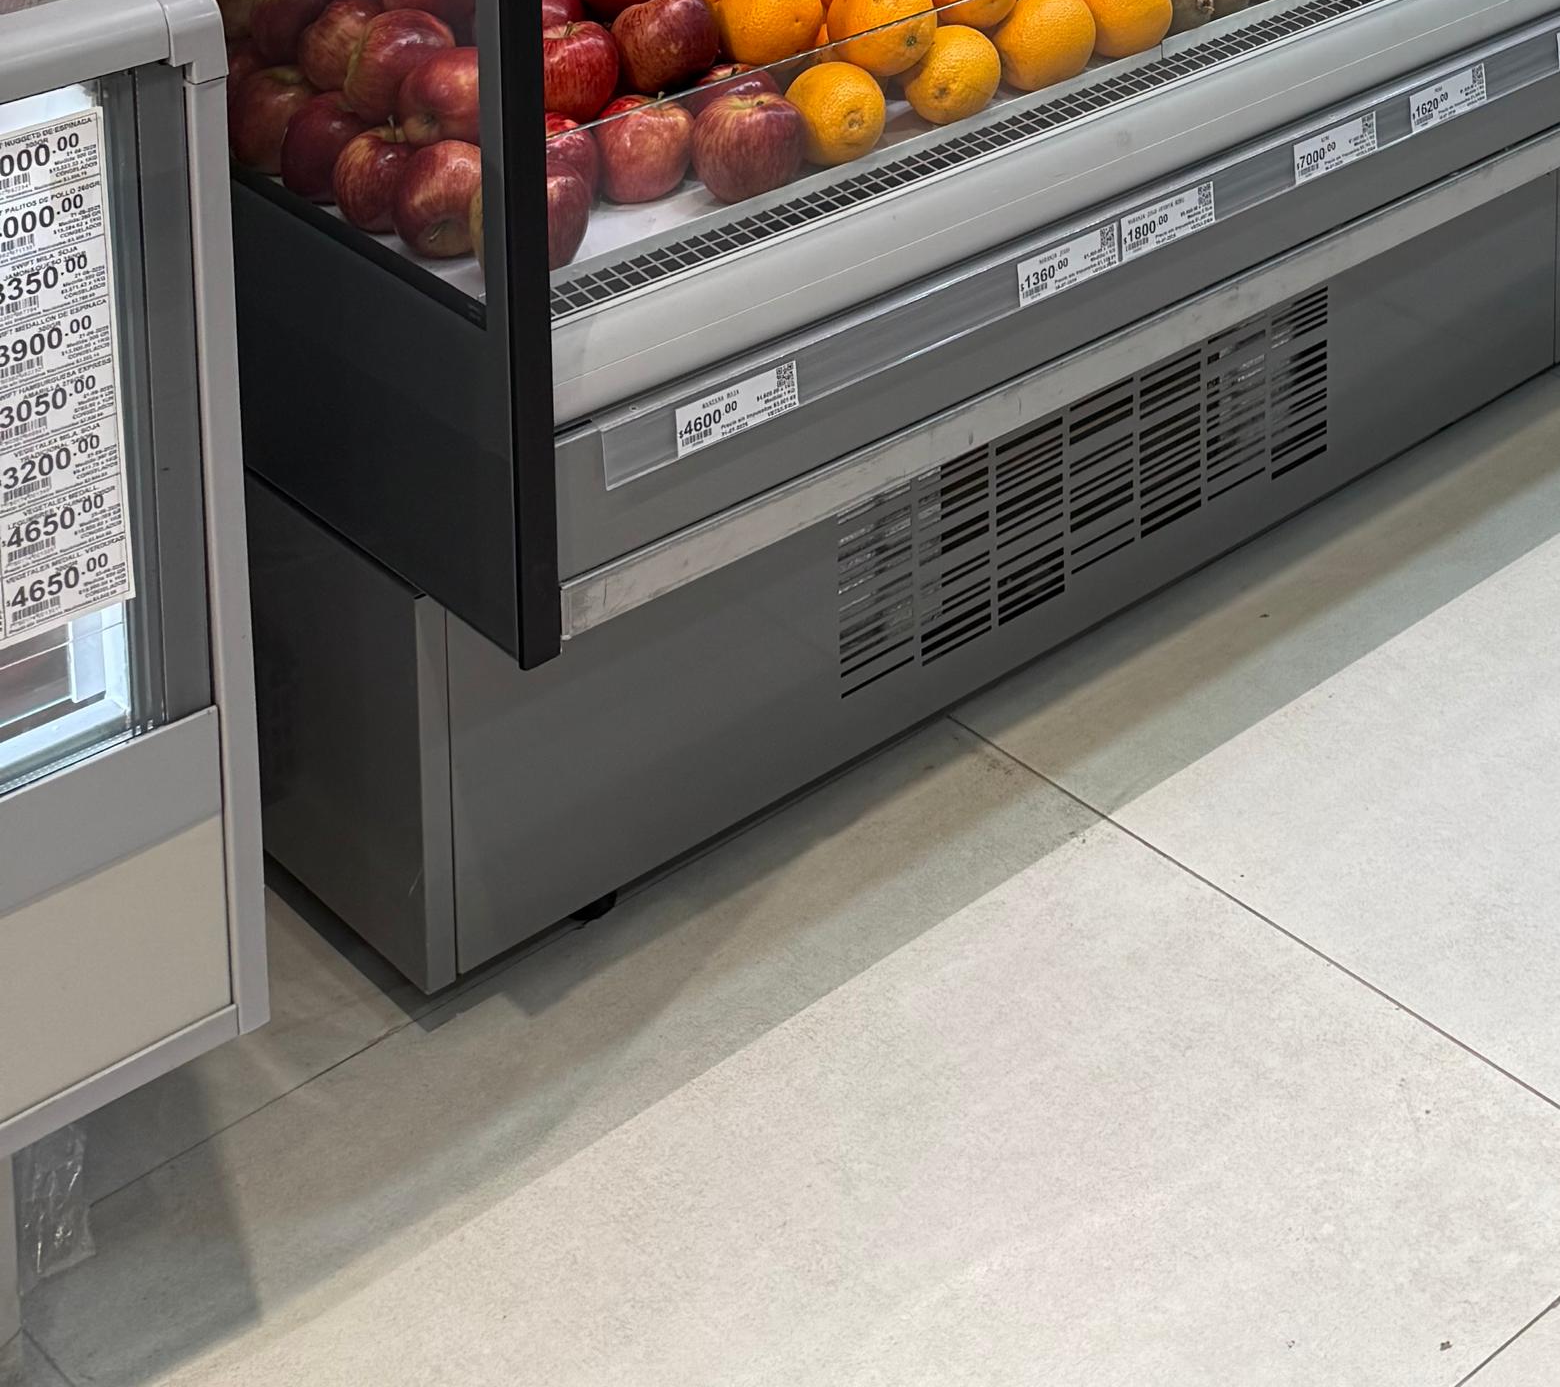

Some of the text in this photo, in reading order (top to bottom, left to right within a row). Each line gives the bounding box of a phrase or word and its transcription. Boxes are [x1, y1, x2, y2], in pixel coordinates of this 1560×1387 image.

[5, 117, 92, 148] NUGGETS DE ESPINACA
[0, 133, 79, 176] 000.00
[55, 161, 98, 178] CONGELADOS
[5, 200, 37, 214] PALITOS
[51, 188, 76, 201] POLLO
[0, 194, 83, 238] 000.00
[58, 246, 78, 256] SOJA
[70, 299, 107, 315] ESPINACA
[78, 357, 112, 374] EXPRESS
[678, 400, 738, 439] $4600.00
[0, 434, 100, 489] 3200.00
